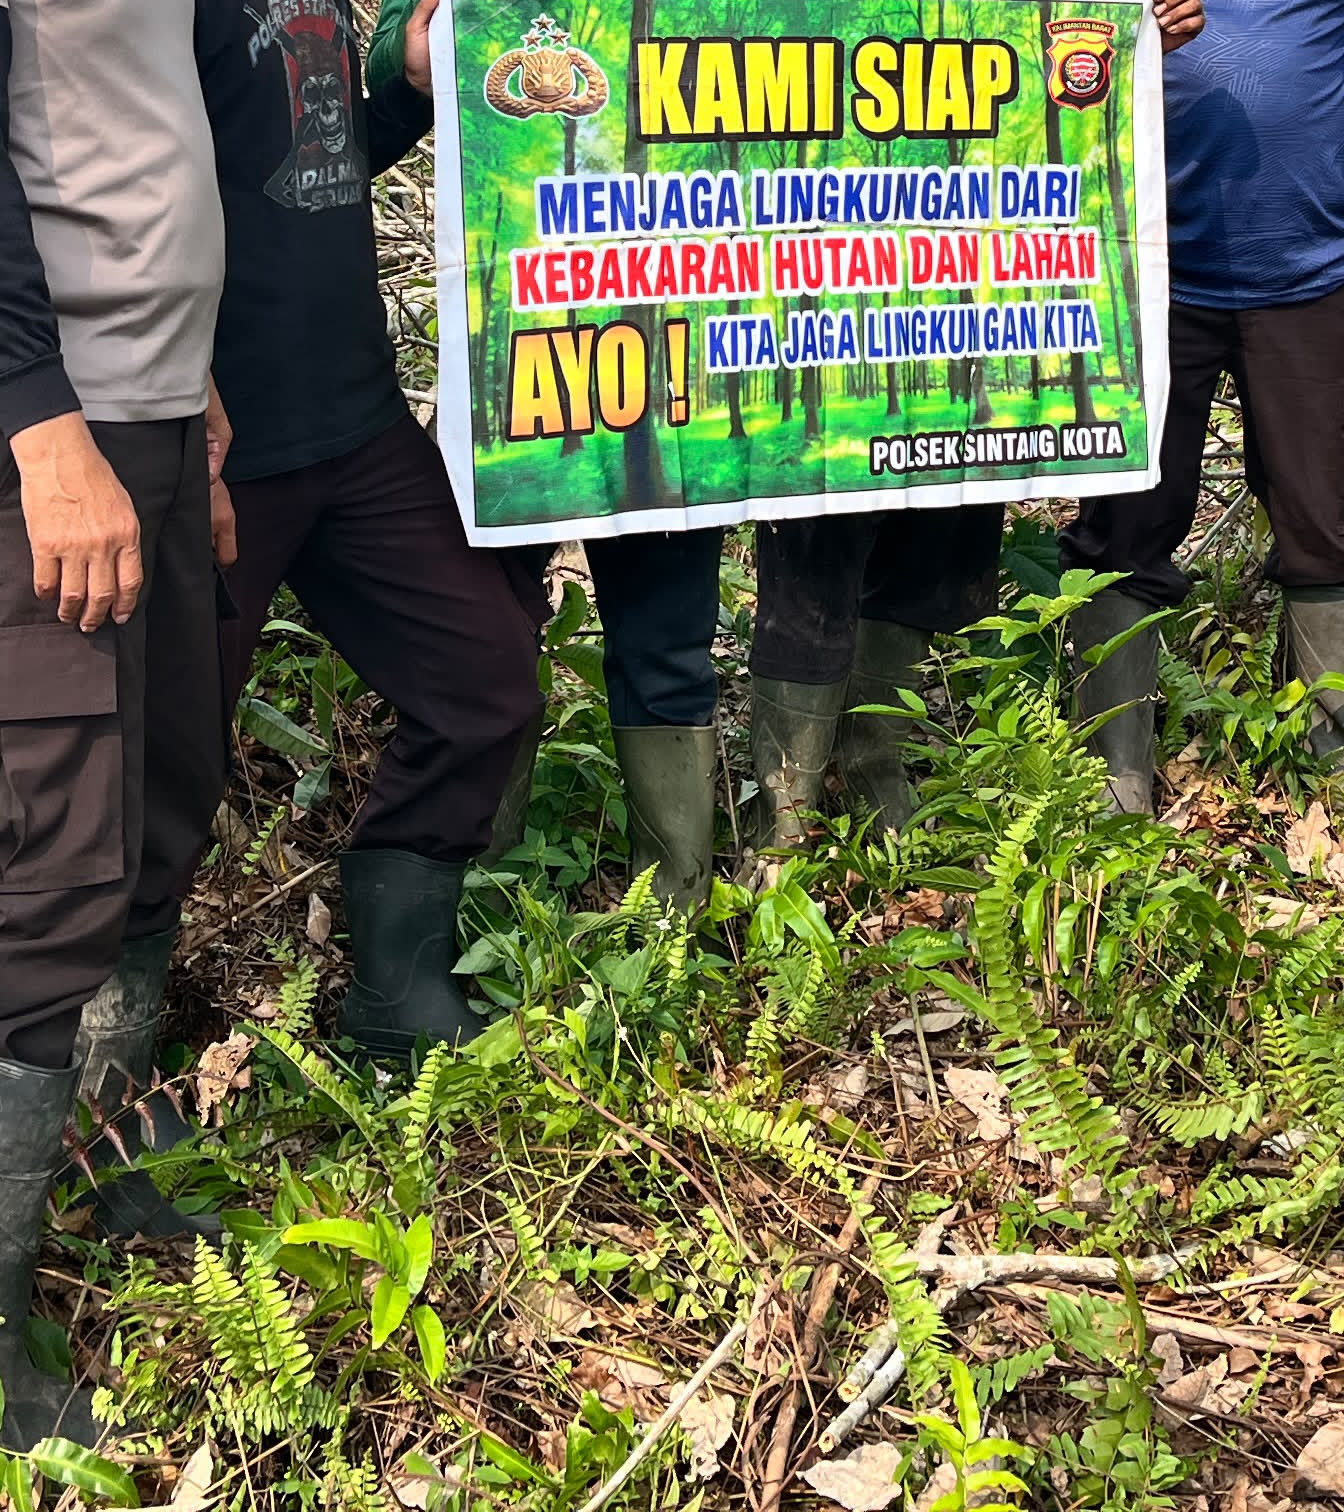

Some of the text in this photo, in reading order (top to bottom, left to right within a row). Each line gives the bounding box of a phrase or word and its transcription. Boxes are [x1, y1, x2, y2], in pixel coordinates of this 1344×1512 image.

[637, 40, 1012, 136] KAMI SIAP
[538, 169, 1080, 236] MENJAGA LINGKUNGAN DARI
[515, 231, 1096, 307] KEBAKARAN HUTAN DAN LAHAN
[708, 304, 1100, 368] KITA JAGA LINGKUNGAN KITA
[509, 324, 647, 437] AYO
[872, 426, 1124, 471] POLSEK SINTANG KOTA
